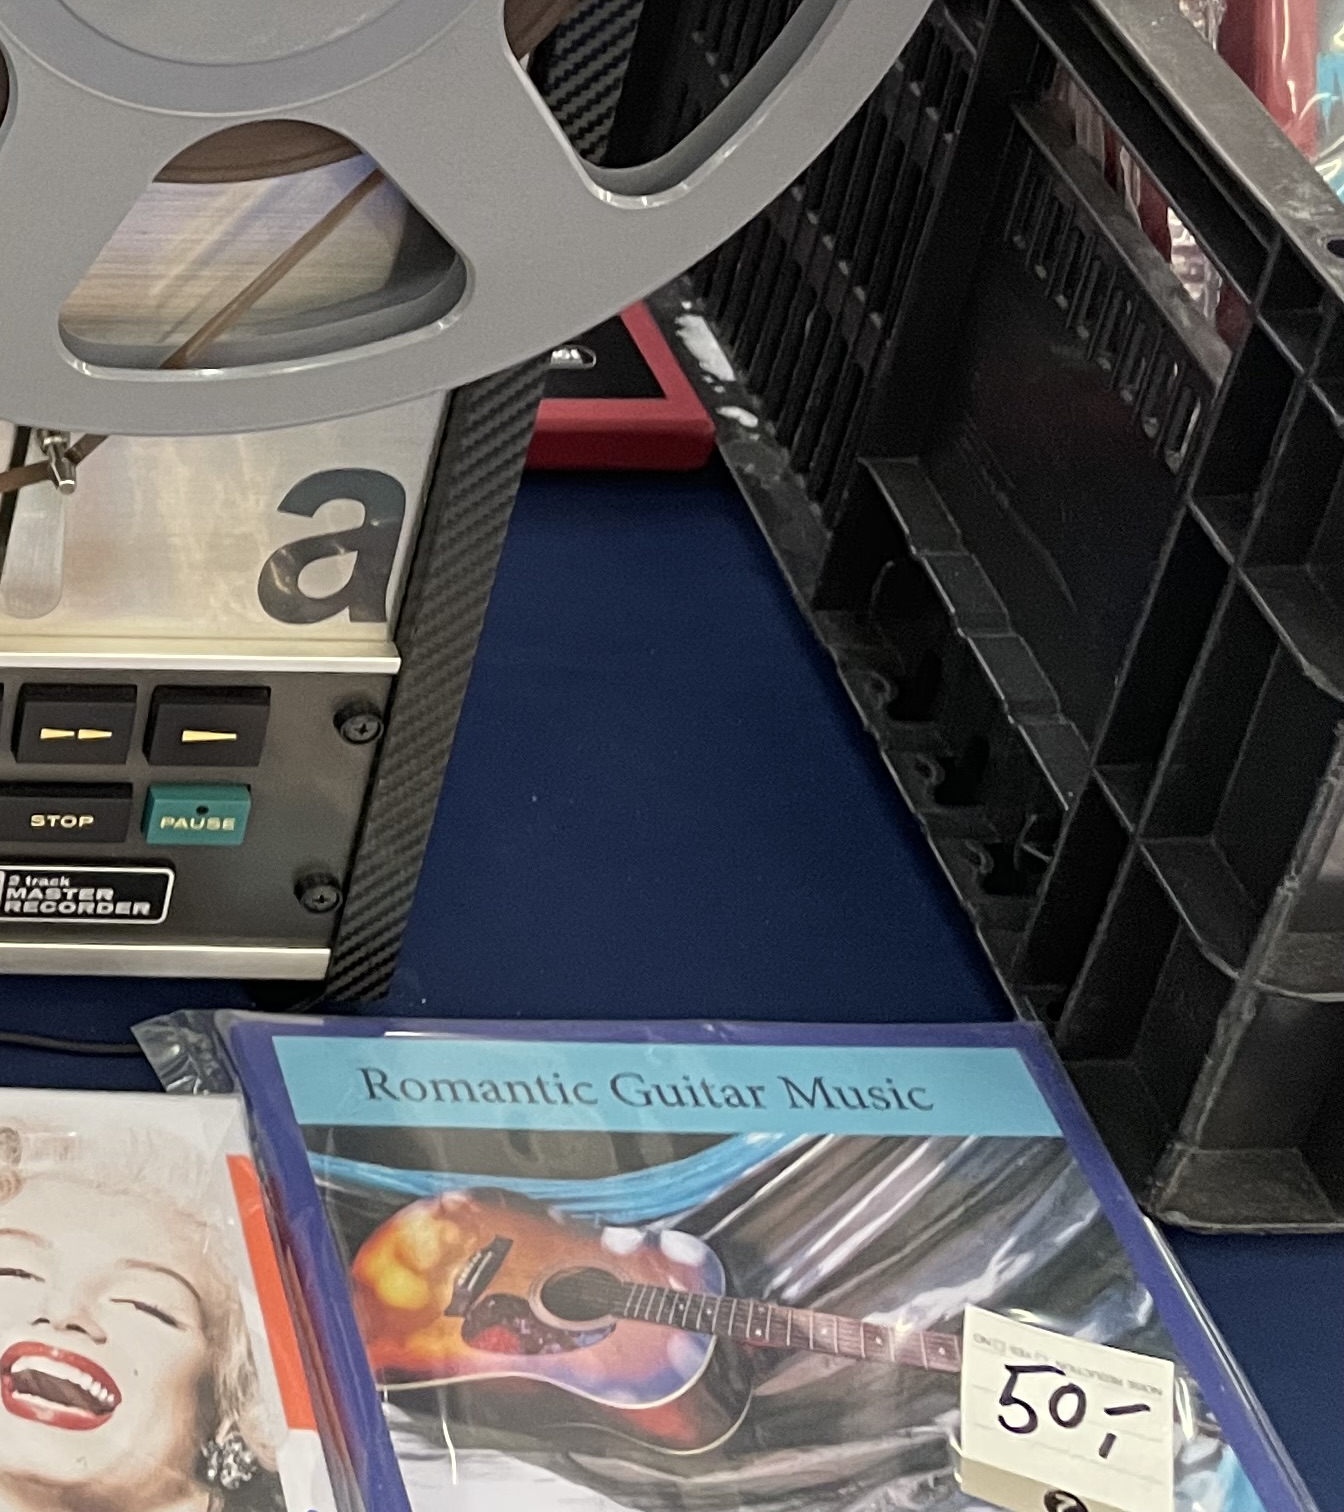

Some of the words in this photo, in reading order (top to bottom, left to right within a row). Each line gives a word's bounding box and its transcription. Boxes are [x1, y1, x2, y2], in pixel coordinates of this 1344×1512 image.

[257, 466, 408, 625] a
[30, 813, 94, 828] STOP
[159, 816, 237, 832] PAUSE
[25, 875, 70, 886] track
[5, 887, 115, 900] MASTER
[3, 900, 152, 916] RECORDER
[356, 1065, 598, 1105] Romantic
[610, 1070, 768, 1111] Guitar
[780, 1074, 935, 1113] Music
